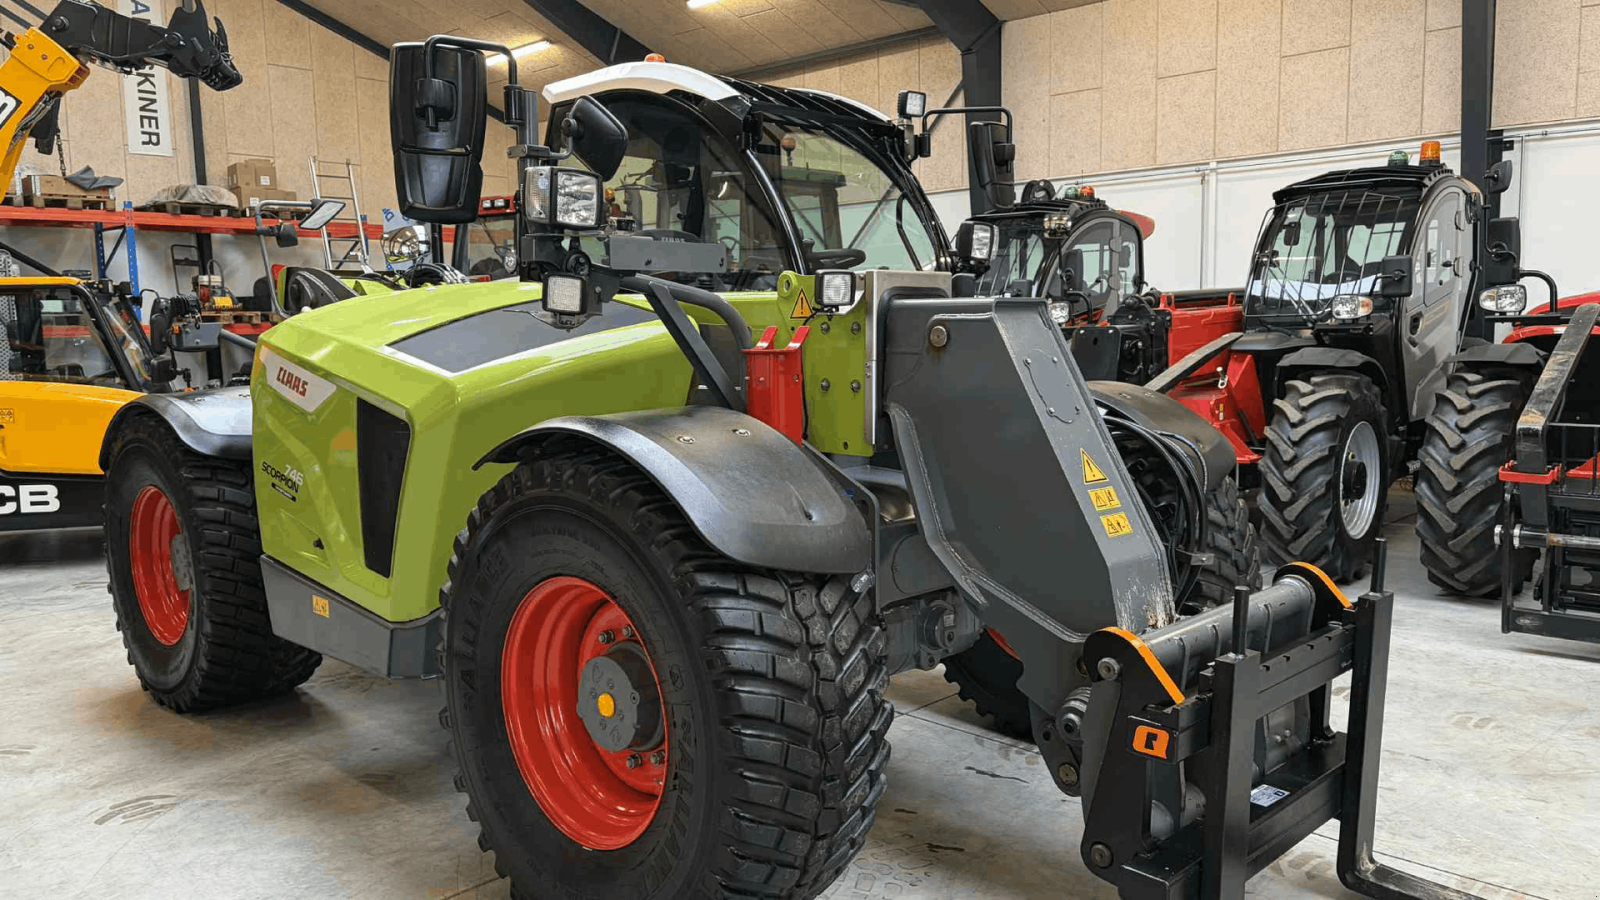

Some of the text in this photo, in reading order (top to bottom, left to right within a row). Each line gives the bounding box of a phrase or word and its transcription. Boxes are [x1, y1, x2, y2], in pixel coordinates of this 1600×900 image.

[276, 366, 309, 397] CLAAS
[261, 461, 299, 493] SCORPION
[284, 464, 304, 486] 746
